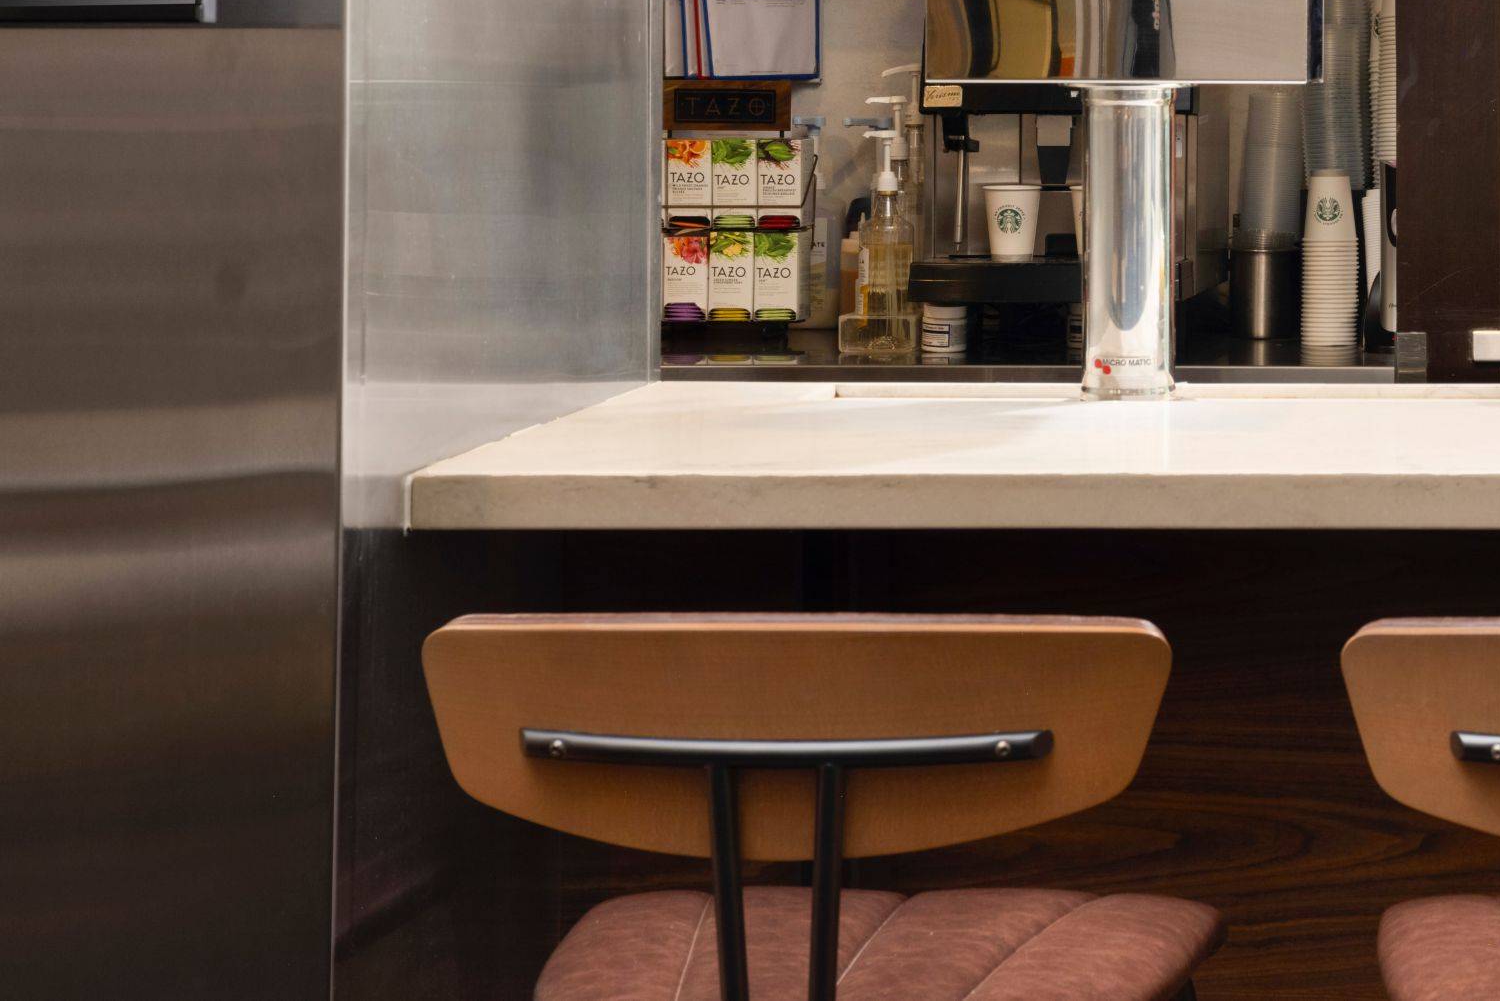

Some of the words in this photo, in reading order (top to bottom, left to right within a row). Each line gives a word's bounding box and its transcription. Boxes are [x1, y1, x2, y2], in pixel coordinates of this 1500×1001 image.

[670, 172, 705, 183] TAZO
[714, 174, 750, 186] TAZO
[760, 174, 795, 186] TAZO
[665, 266, 696, 276] TAZO
[711, 266, 747, 278] TAZO
[756, 267, 791, 279] TAZO
[1103, 358, 1126, 367] MICRO
[1128, 358, 1152, 367] MATIC
